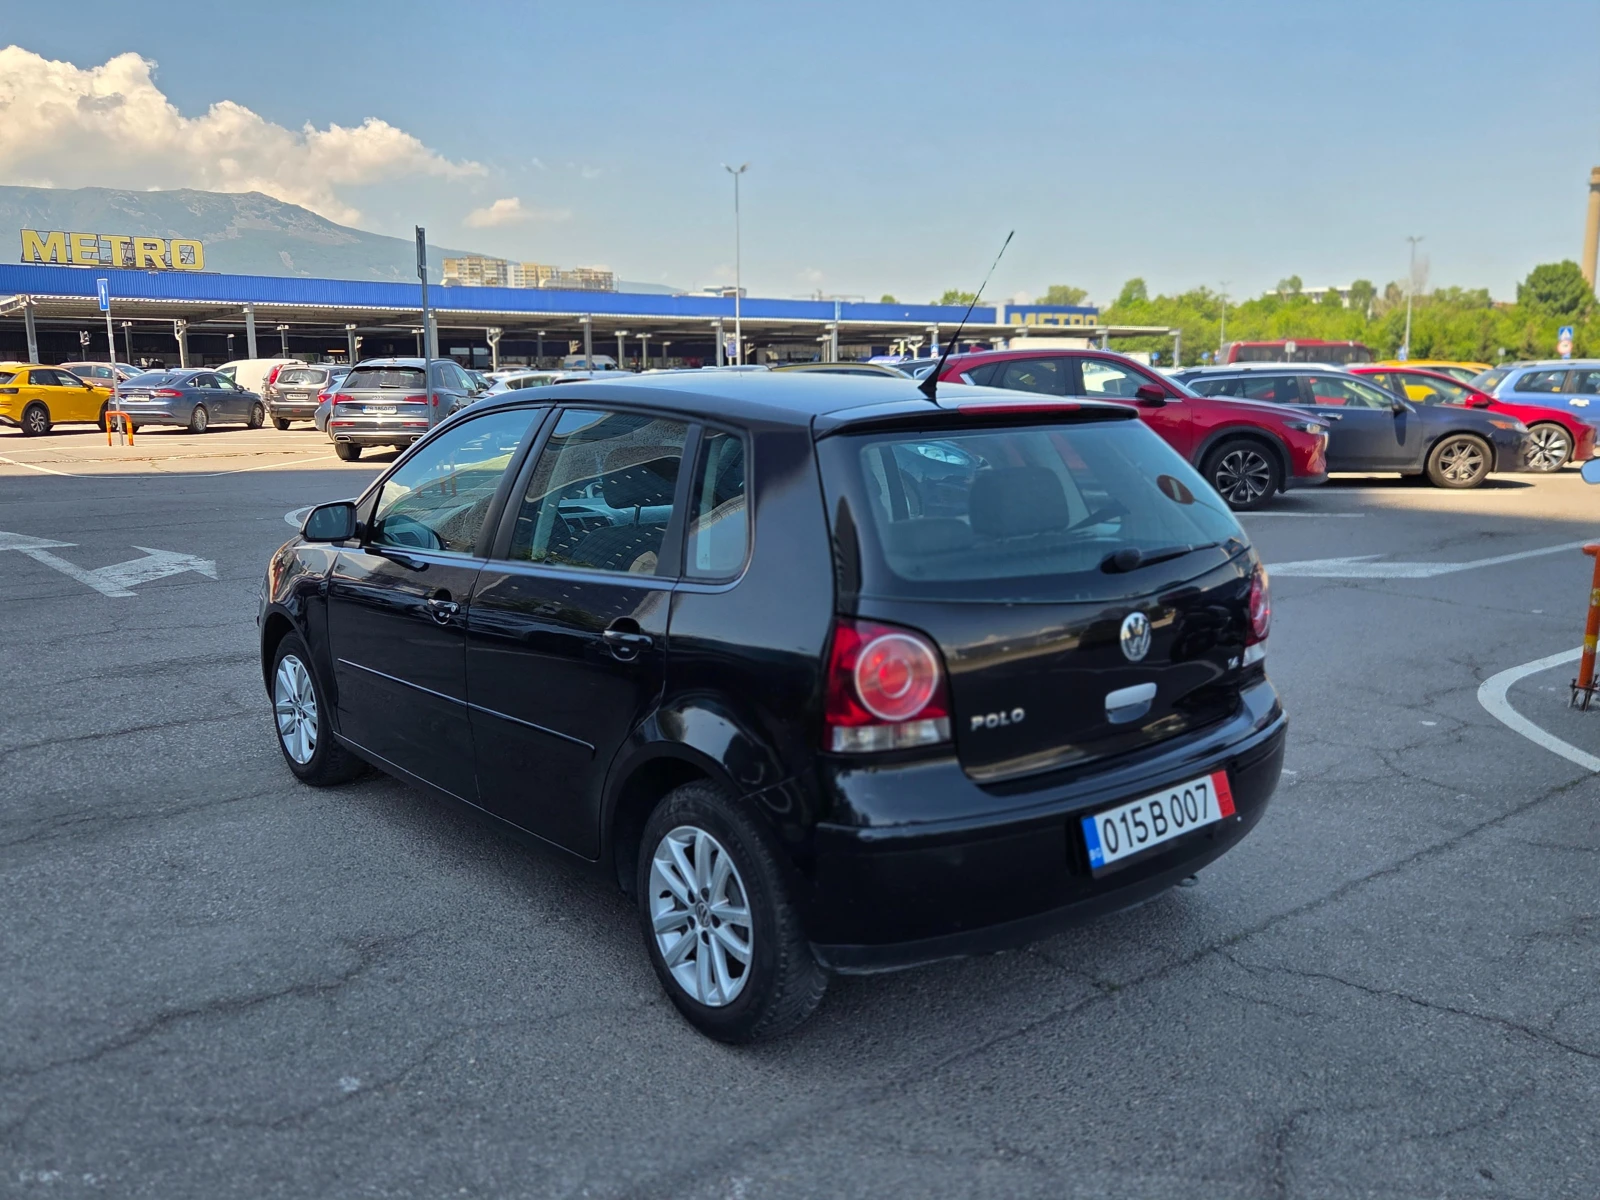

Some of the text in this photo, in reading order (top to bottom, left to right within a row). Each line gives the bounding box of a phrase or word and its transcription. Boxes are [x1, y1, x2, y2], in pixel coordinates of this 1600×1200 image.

[20, 229, 205, 271] METRO
[1009, 311, 1098, 326] METRO
[970, 707, 1025, 732] POLO
